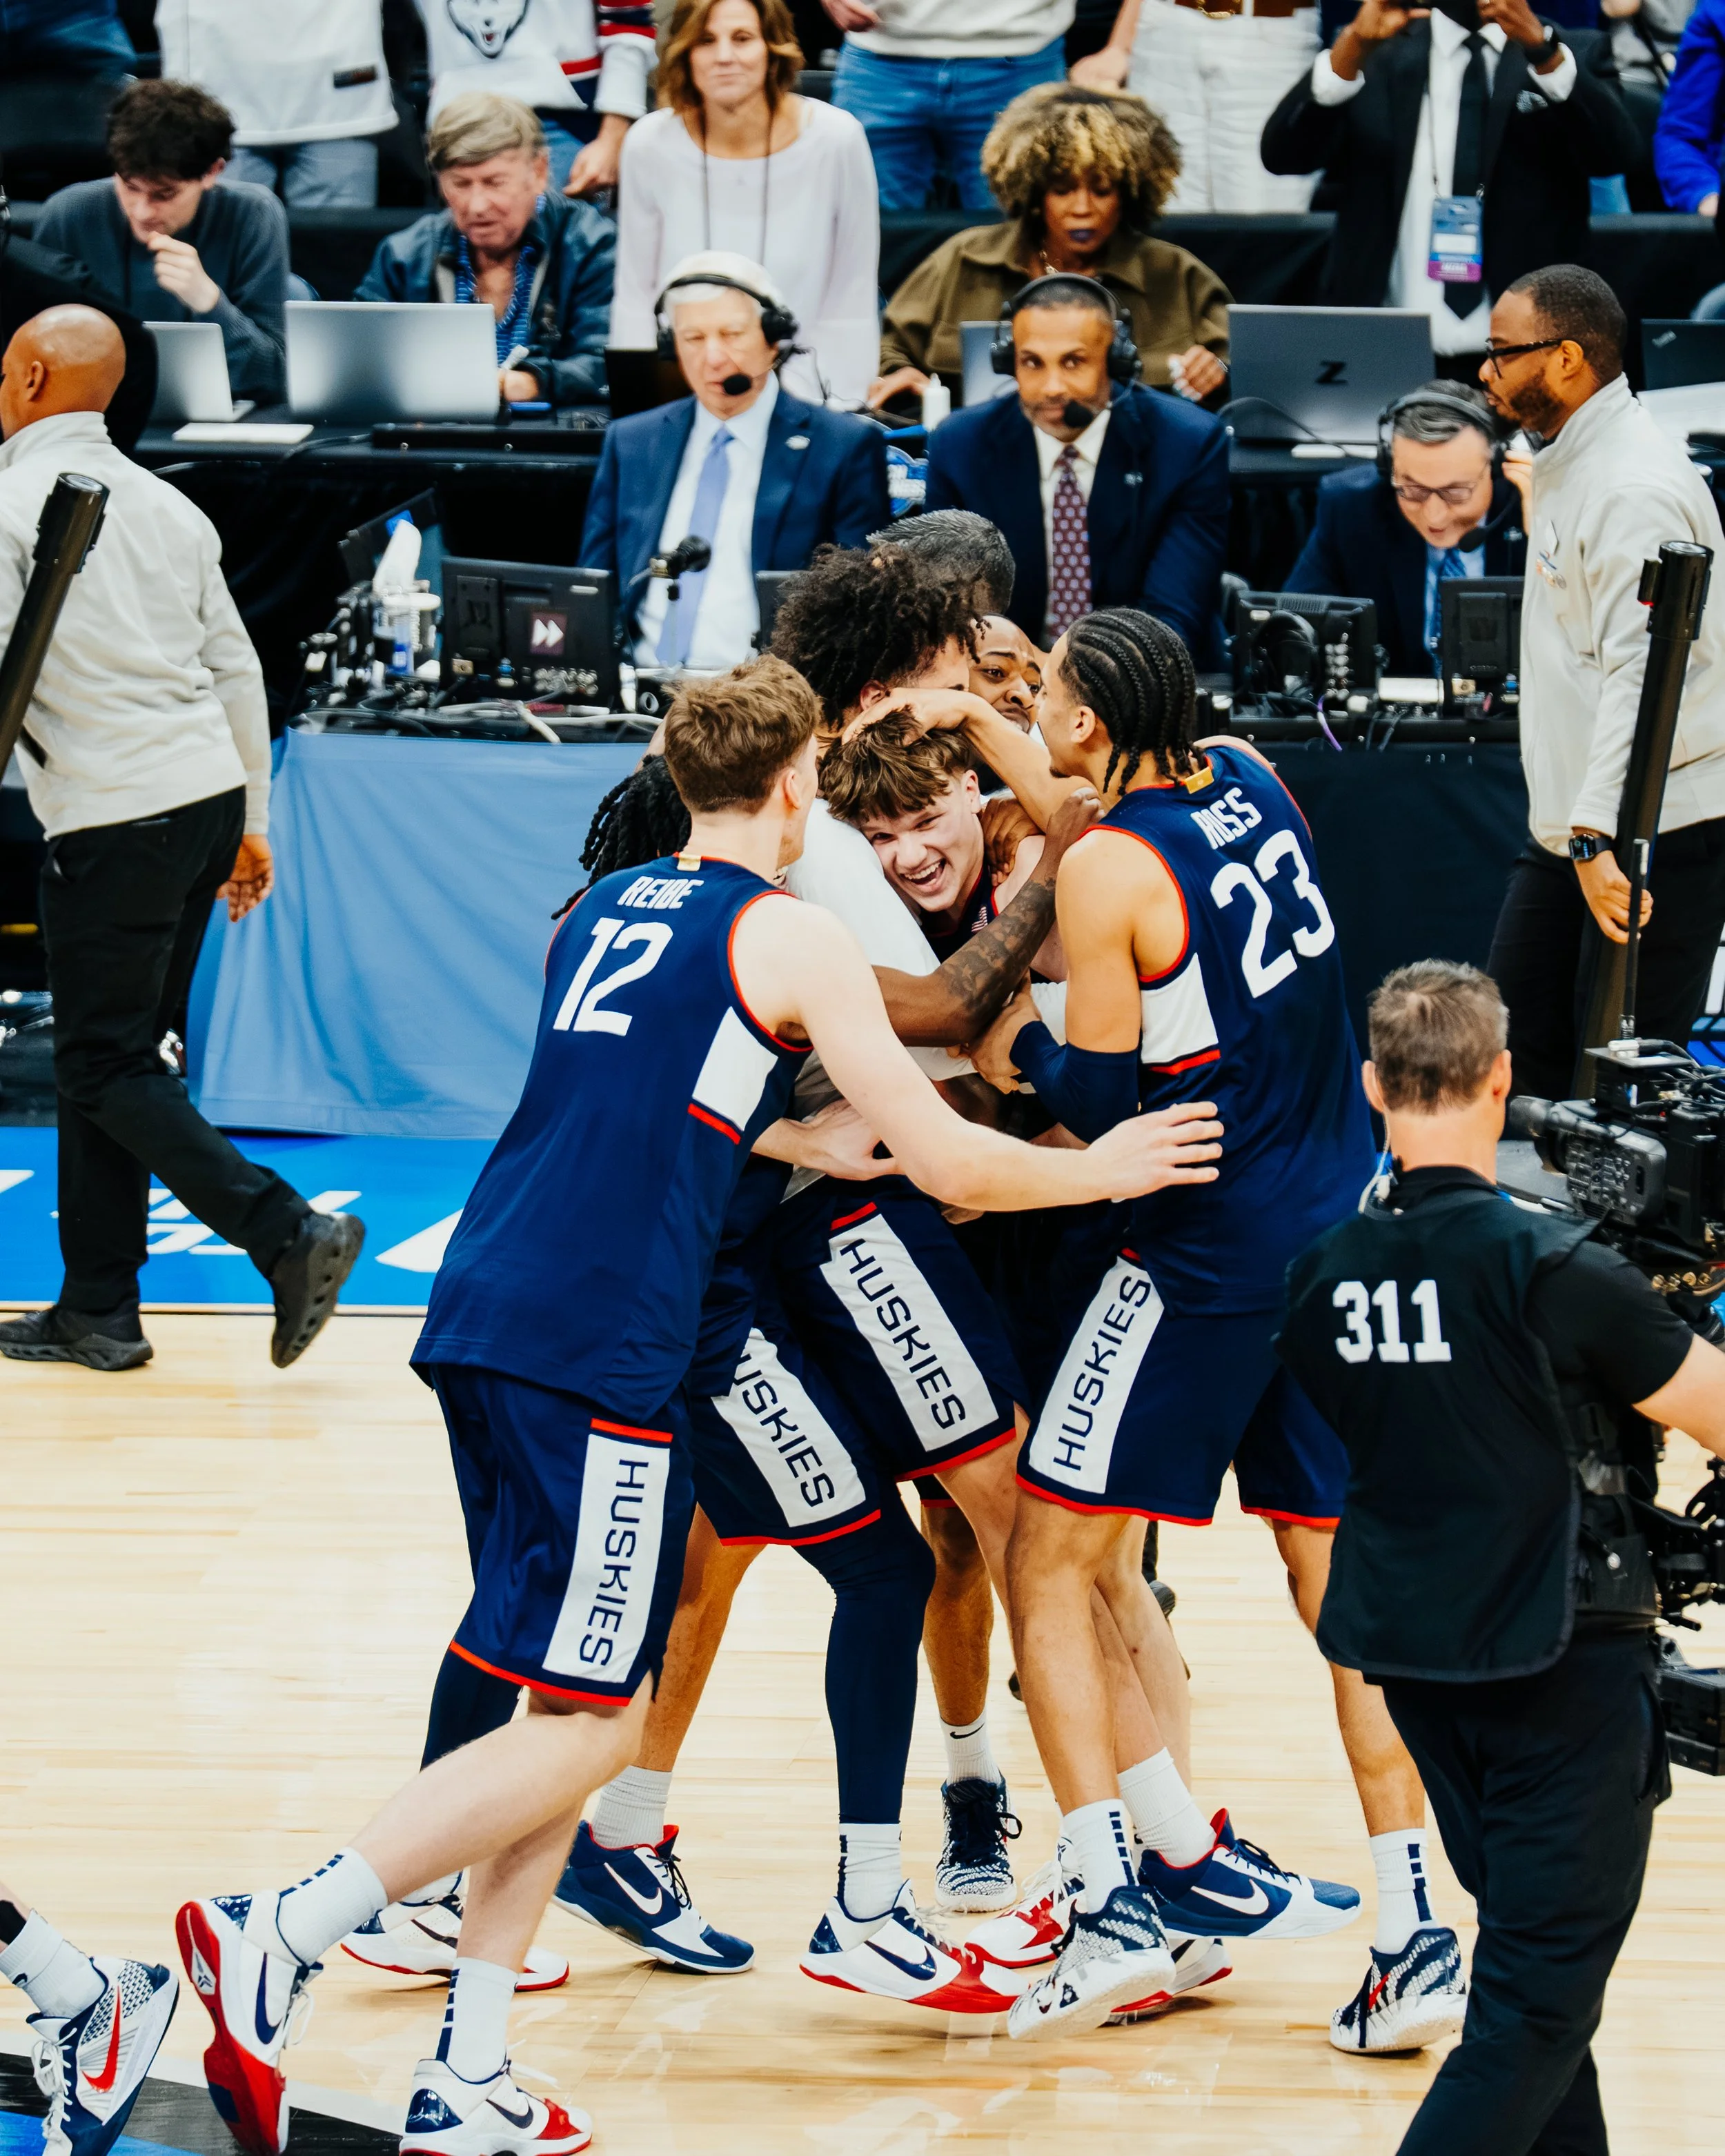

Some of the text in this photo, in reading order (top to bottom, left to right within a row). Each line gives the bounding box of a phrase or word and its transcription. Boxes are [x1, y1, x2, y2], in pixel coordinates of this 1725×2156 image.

[1191, 788, 1262, 849] ROSS
[618, 876, 704, 909] REIBE
[1210, 829, 1334, 998] 23
[553, 917, 673, 1036] 12
[840, 1238, 965, 1429] HUSKIES
[1053, 1276, 1150, 1470] HUSKIES
[1332, 1280, 1452, 1363] 311
[580, 1459, 649, 1665] HUSKIES
